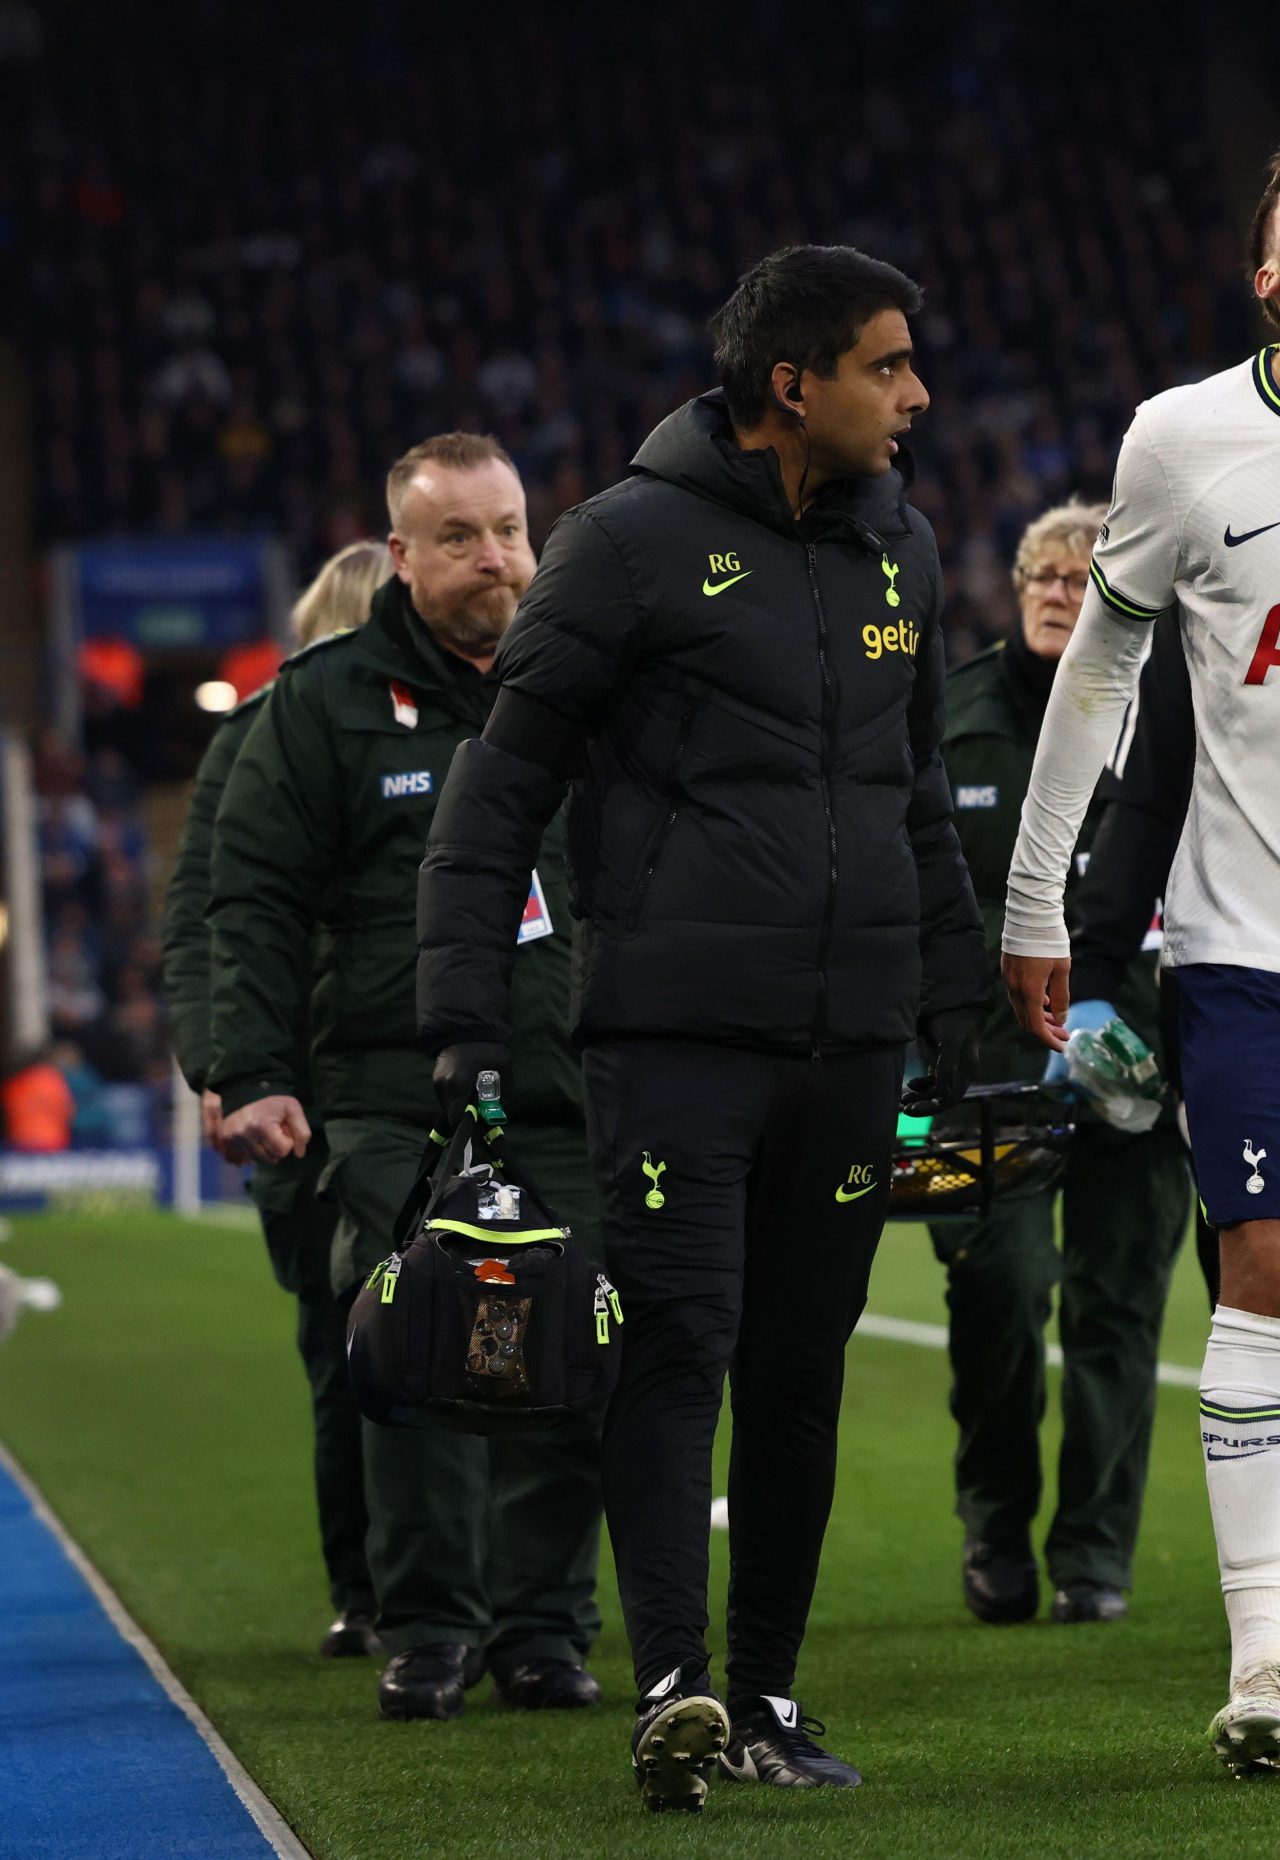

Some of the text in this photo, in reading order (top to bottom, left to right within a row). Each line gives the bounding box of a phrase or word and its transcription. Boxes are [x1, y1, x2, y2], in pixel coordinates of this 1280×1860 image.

[708, 552, 741, 574] RG
[862, 619, 919, 660] getir
[383, 771, 431, 797] NHS
[847, 1164, 874, 1184] RG
